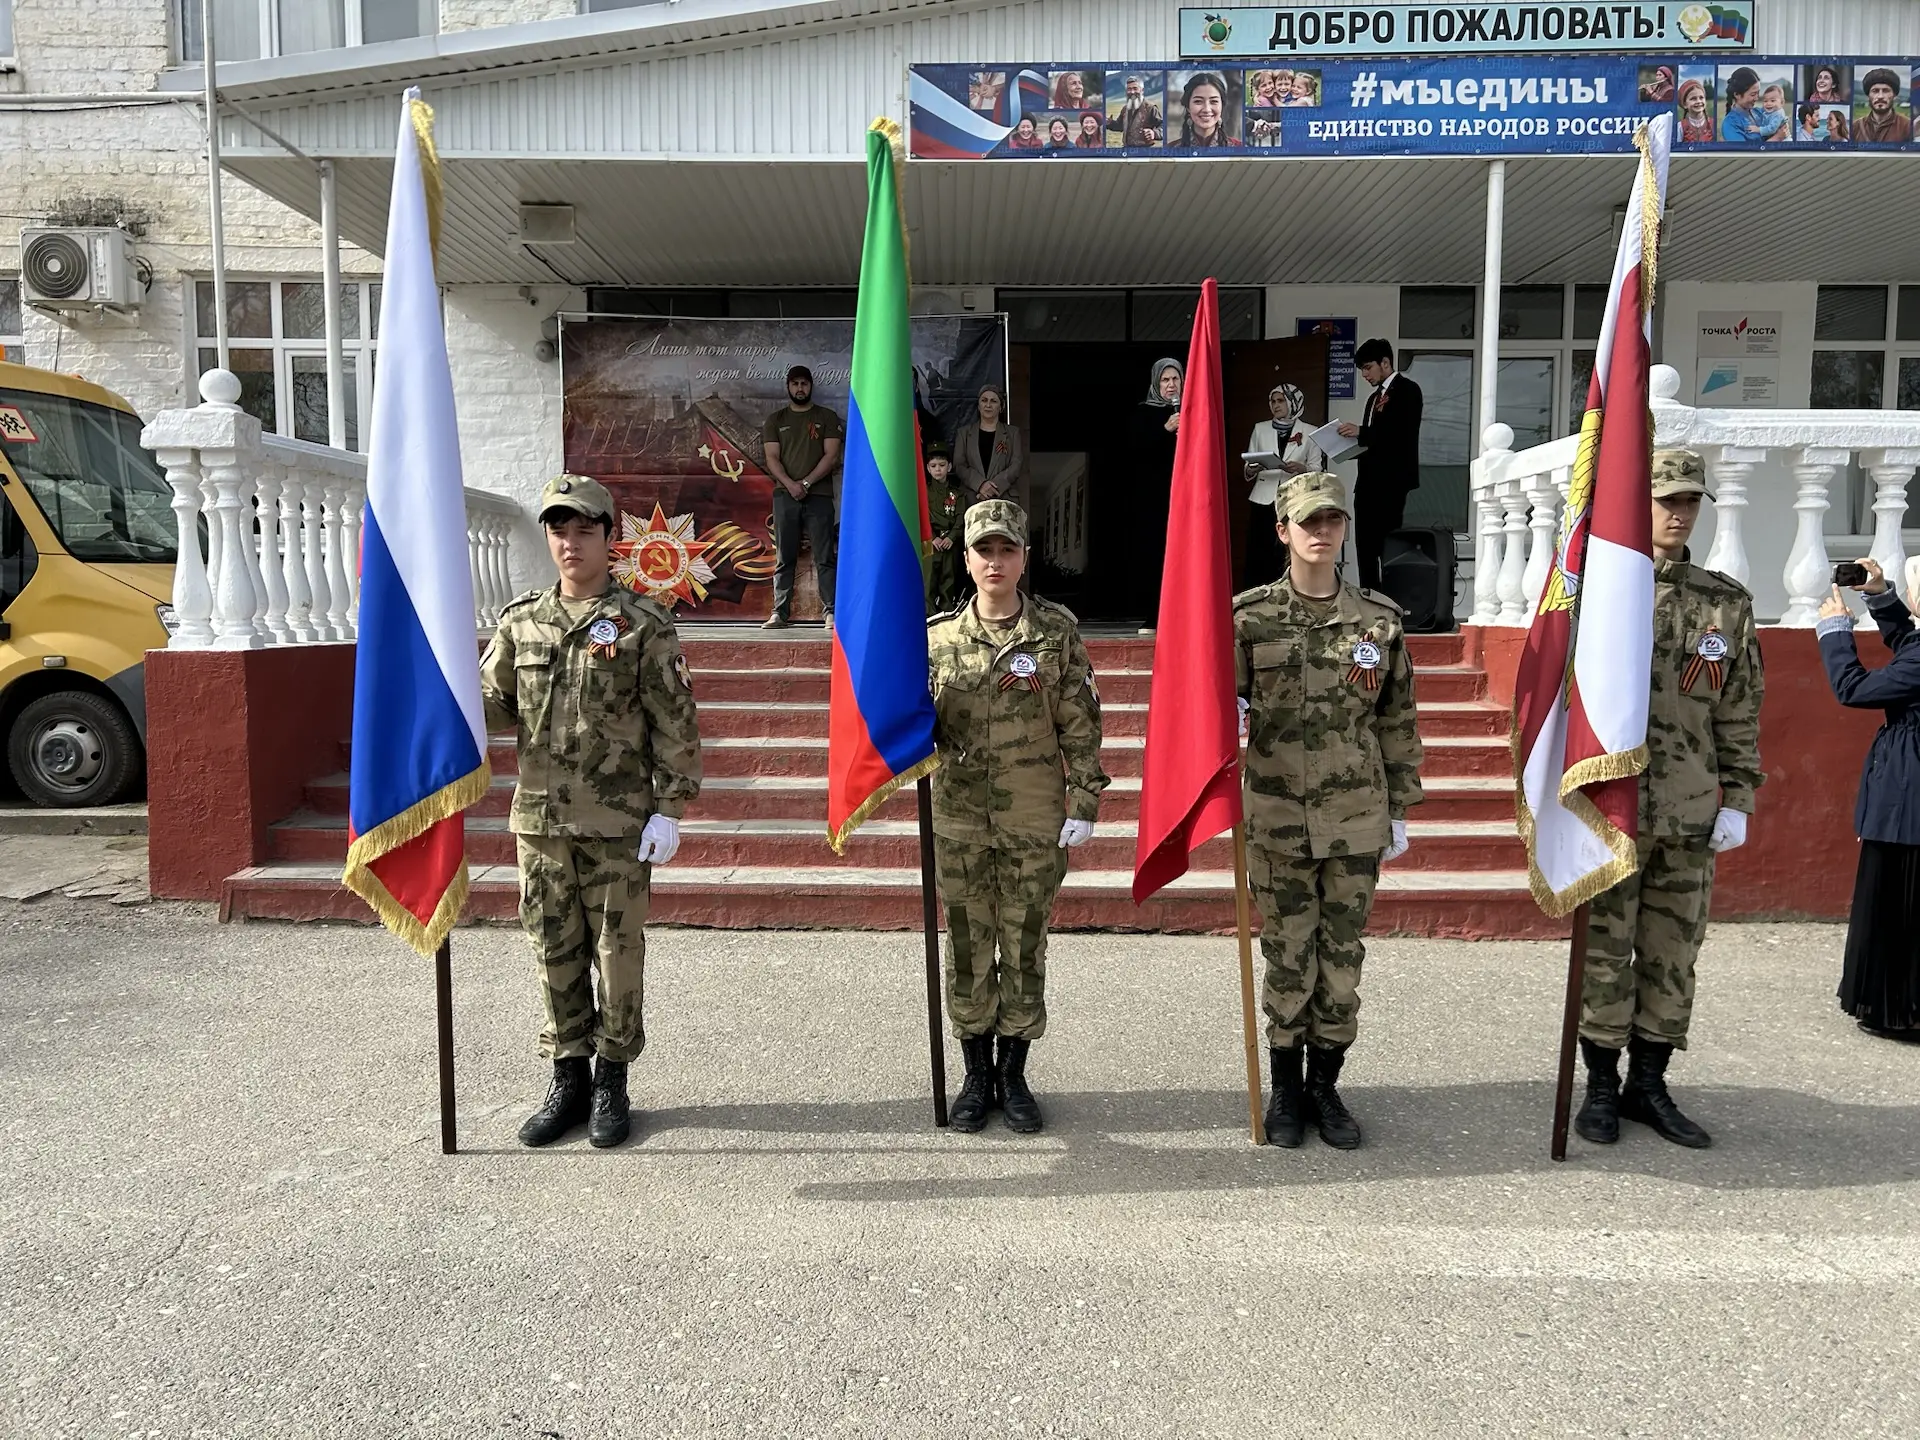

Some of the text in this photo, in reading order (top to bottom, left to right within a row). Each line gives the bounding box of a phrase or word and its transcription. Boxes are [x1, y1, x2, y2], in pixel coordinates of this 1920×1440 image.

[1268, 5, 1666, 51] ДОБРО ПОЖАЛОВАТЬ!
[1350, 72, 1609, 112] #мыедины
[1307, 119, 1433, 141] ЕДИНСТВО
[1439, 117, 1550, 140] НАРОДОВ
[1555, 116, 1650, 136] РОССИИ
[1702, 327, 1777, 335] ТОЧКА РОСТА
[625, 333, 779, 362] Лишь тот народ
[695, 367, 741, 385] ждет
[745, 364, 790, 380] велик
